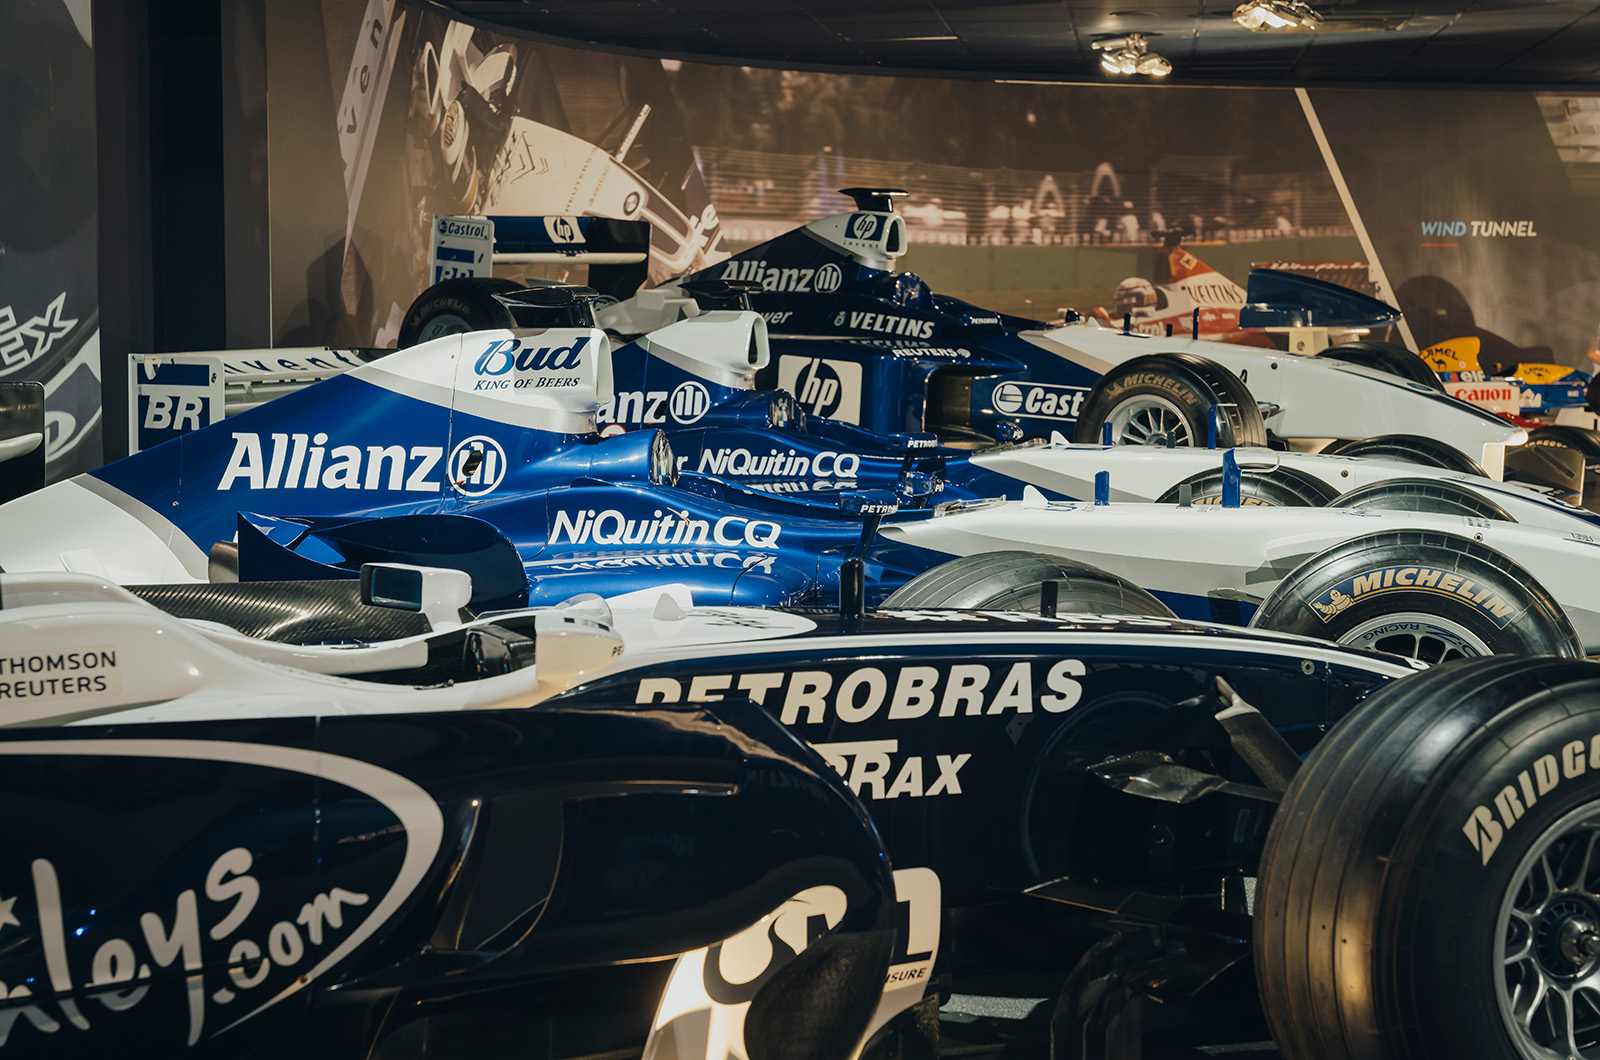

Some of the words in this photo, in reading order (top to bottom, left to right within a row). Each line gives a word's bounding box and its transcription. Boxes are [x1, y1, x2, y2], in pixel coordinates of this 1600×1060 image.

[447, 221, 485, 237] Castrol
[1421, 221, 1467, 237] WIND
[1470, 220, 1537, 238] TUNNEL
[720, 260, 815, 292] Allianz
[849, 311, 935, 339] VELTINS
[474, 336, 592, 376] Bud
[892, 348, 958, 359] REUTERS
[1418, 347, 1459, 361] CAMEL
[473, 379, 511, 391] KING
[513, 378, 533, 389] OF
[535, 376, 581, 388] BEERS
[799, 357, 839, 417] hp
[1123, 373, 1199, 404] MICHELIN
[143, 395, 203, 431] BR
[217, 432, 443, 492] Allianz
[1352, 567, 1514, 619] MICHELIN
[1362, 623, 1421, 642] RACING
[0, 651, 117, 676] THOMSON
[0, 675, 107, 700] REUTERS
[635, 658, 1086, 725] PETROBRAS
